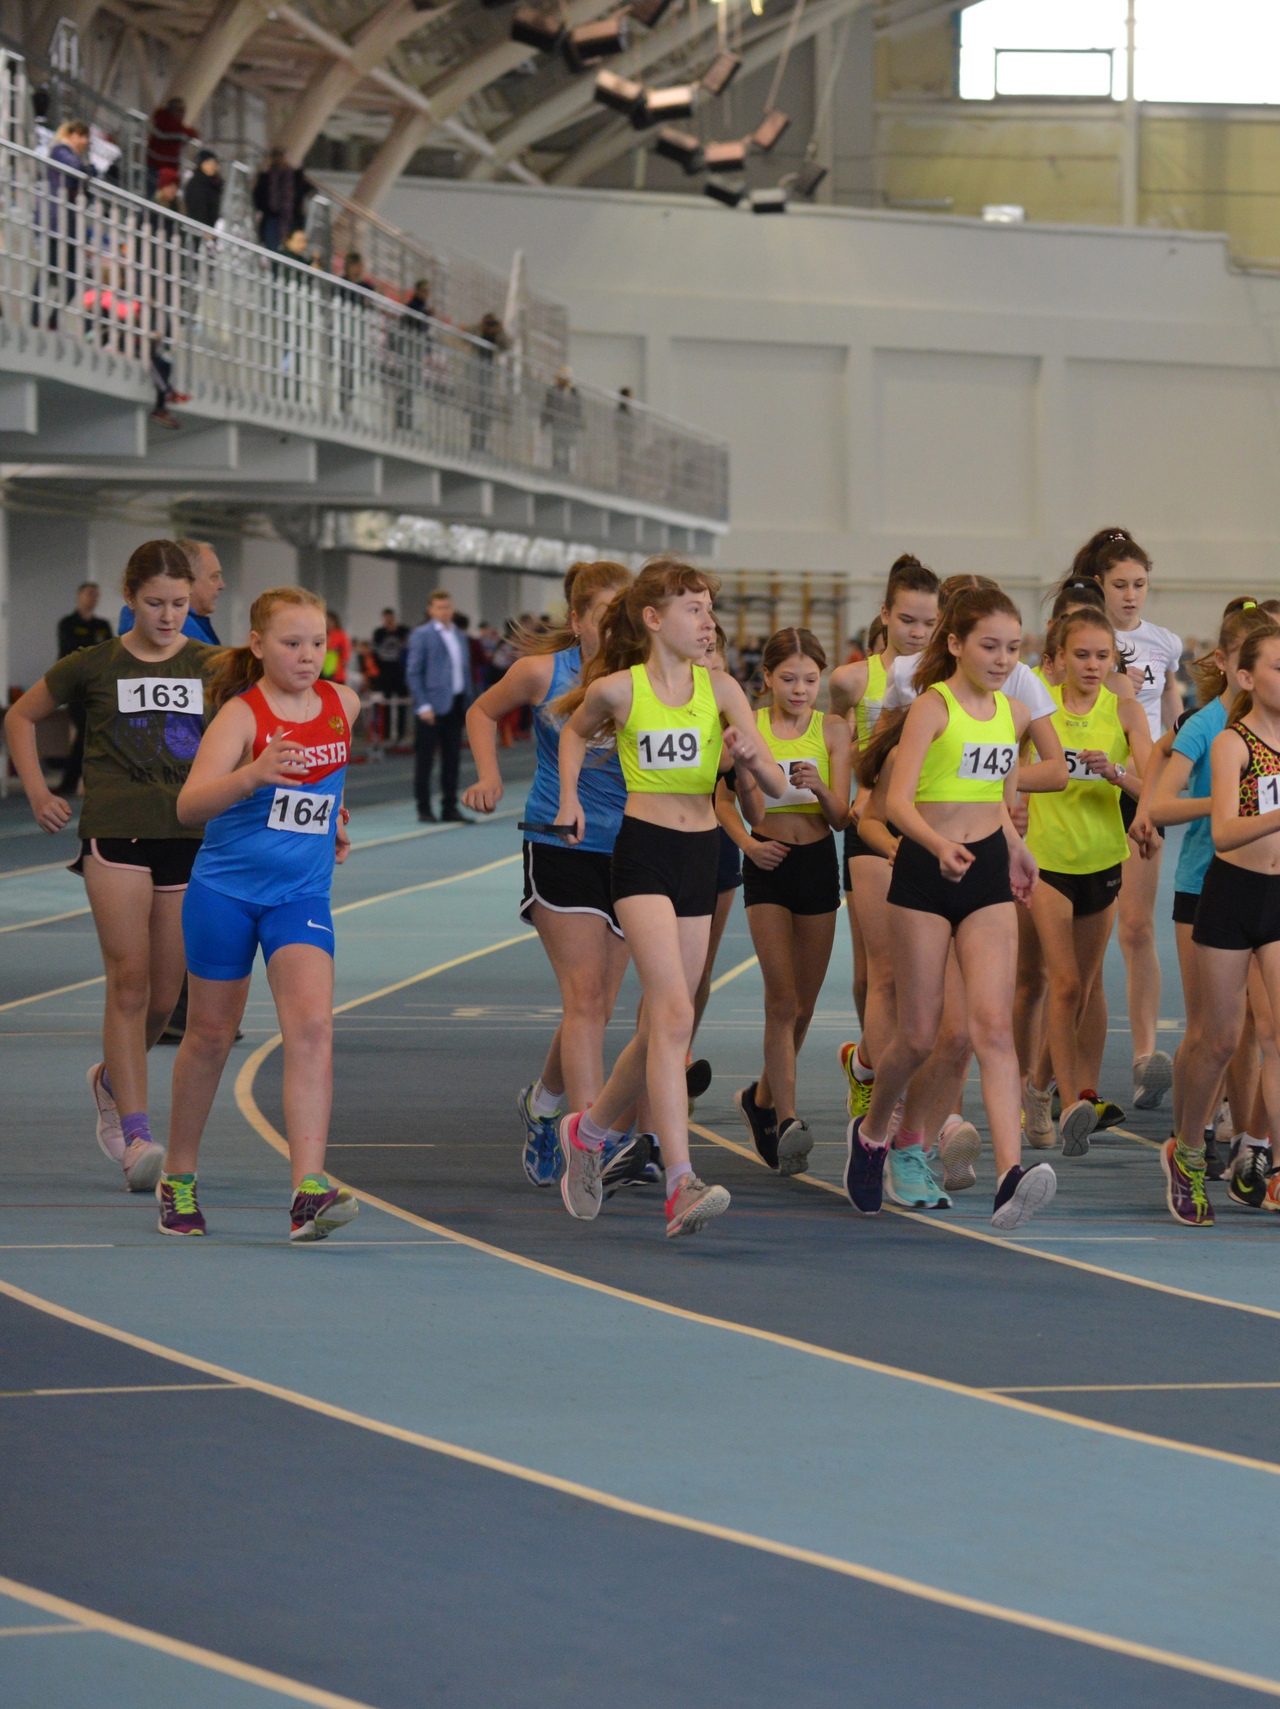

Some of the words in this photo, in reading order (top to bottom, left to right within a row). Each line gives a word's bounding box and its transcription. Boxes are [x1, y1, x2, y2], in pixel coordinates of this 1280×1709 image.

[133, 684, 189, 708] 163
[640, 733, 697, 763] 149
[969, 747, 1013, 775] 143
[275, 795, 329, 826] 164
